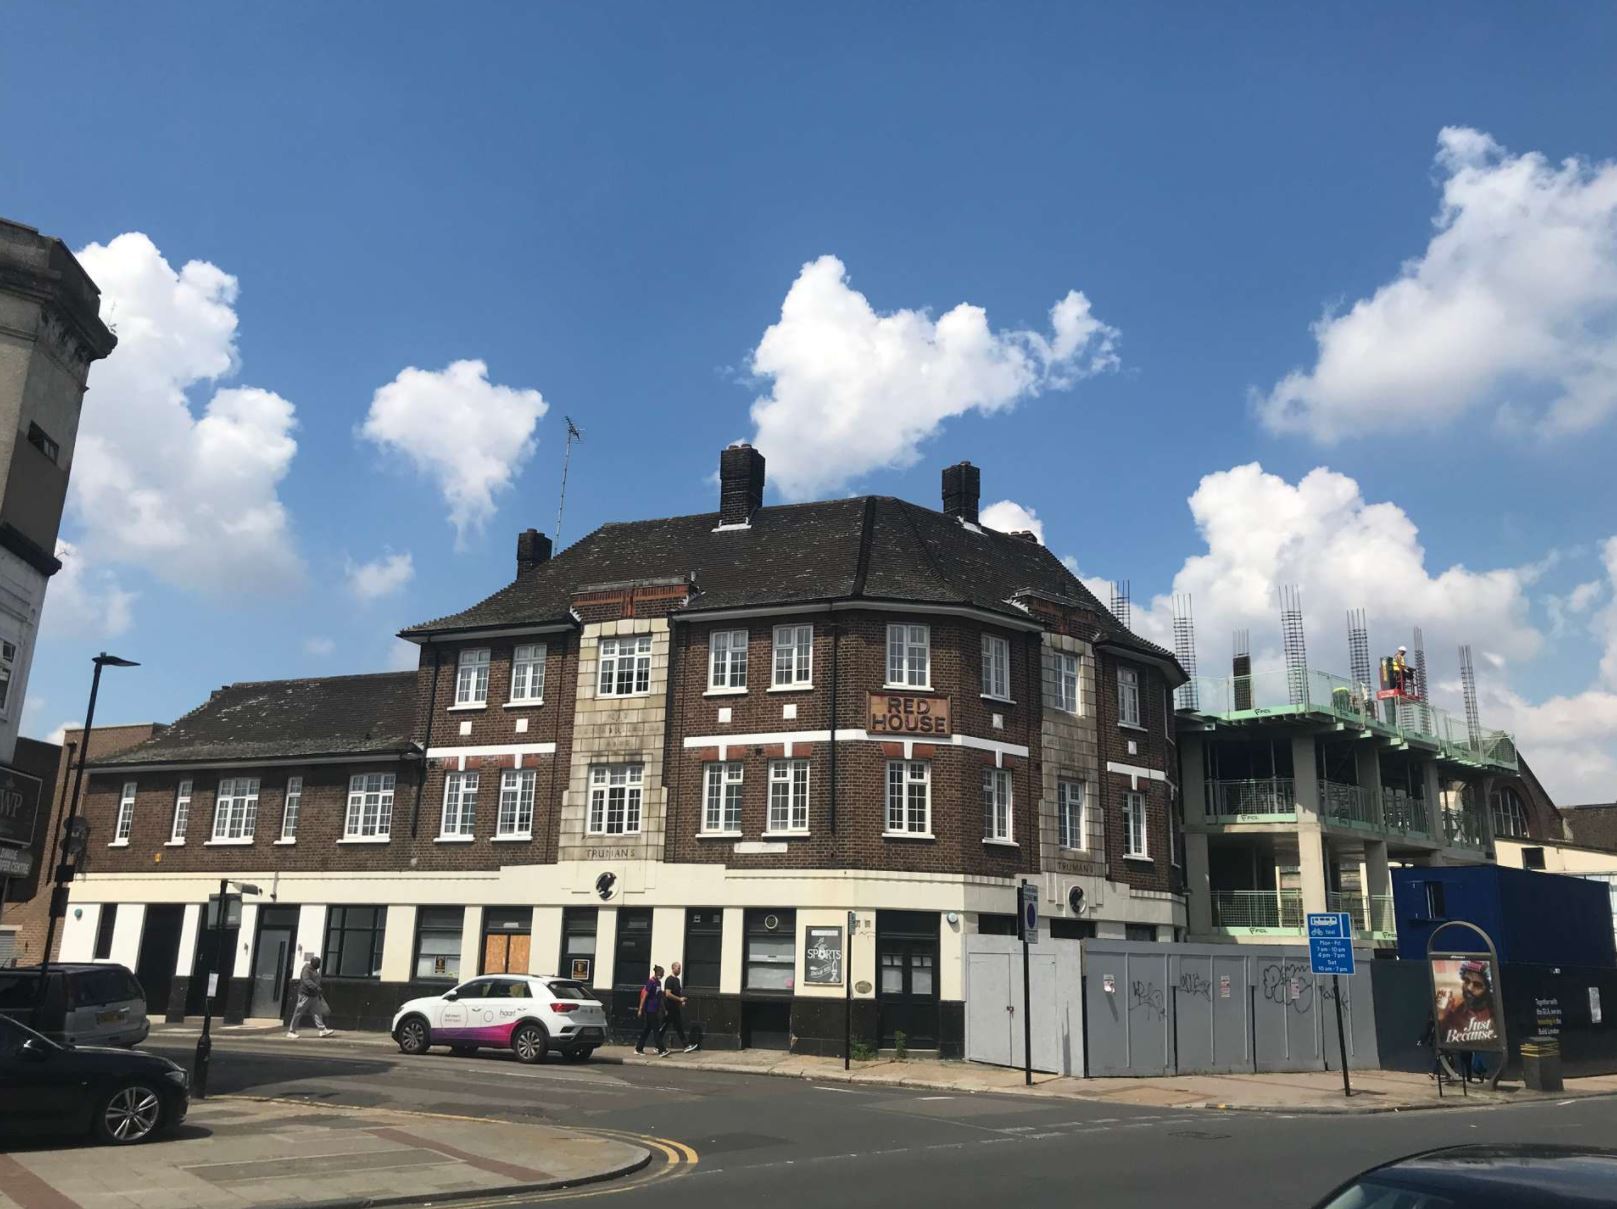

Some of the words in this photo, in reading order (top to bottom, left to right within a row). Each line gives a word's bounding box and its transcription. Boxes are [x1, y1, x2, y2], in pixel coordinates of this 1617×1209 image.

[888, 696, 930, 715] RED
[872, 713, 946, 733] HOUSE
[807, 948, 841, 960] SPORTS
[1463, 1016, 1491, 1031] Just
[1446, 1029, 1498, 1042] Because.
